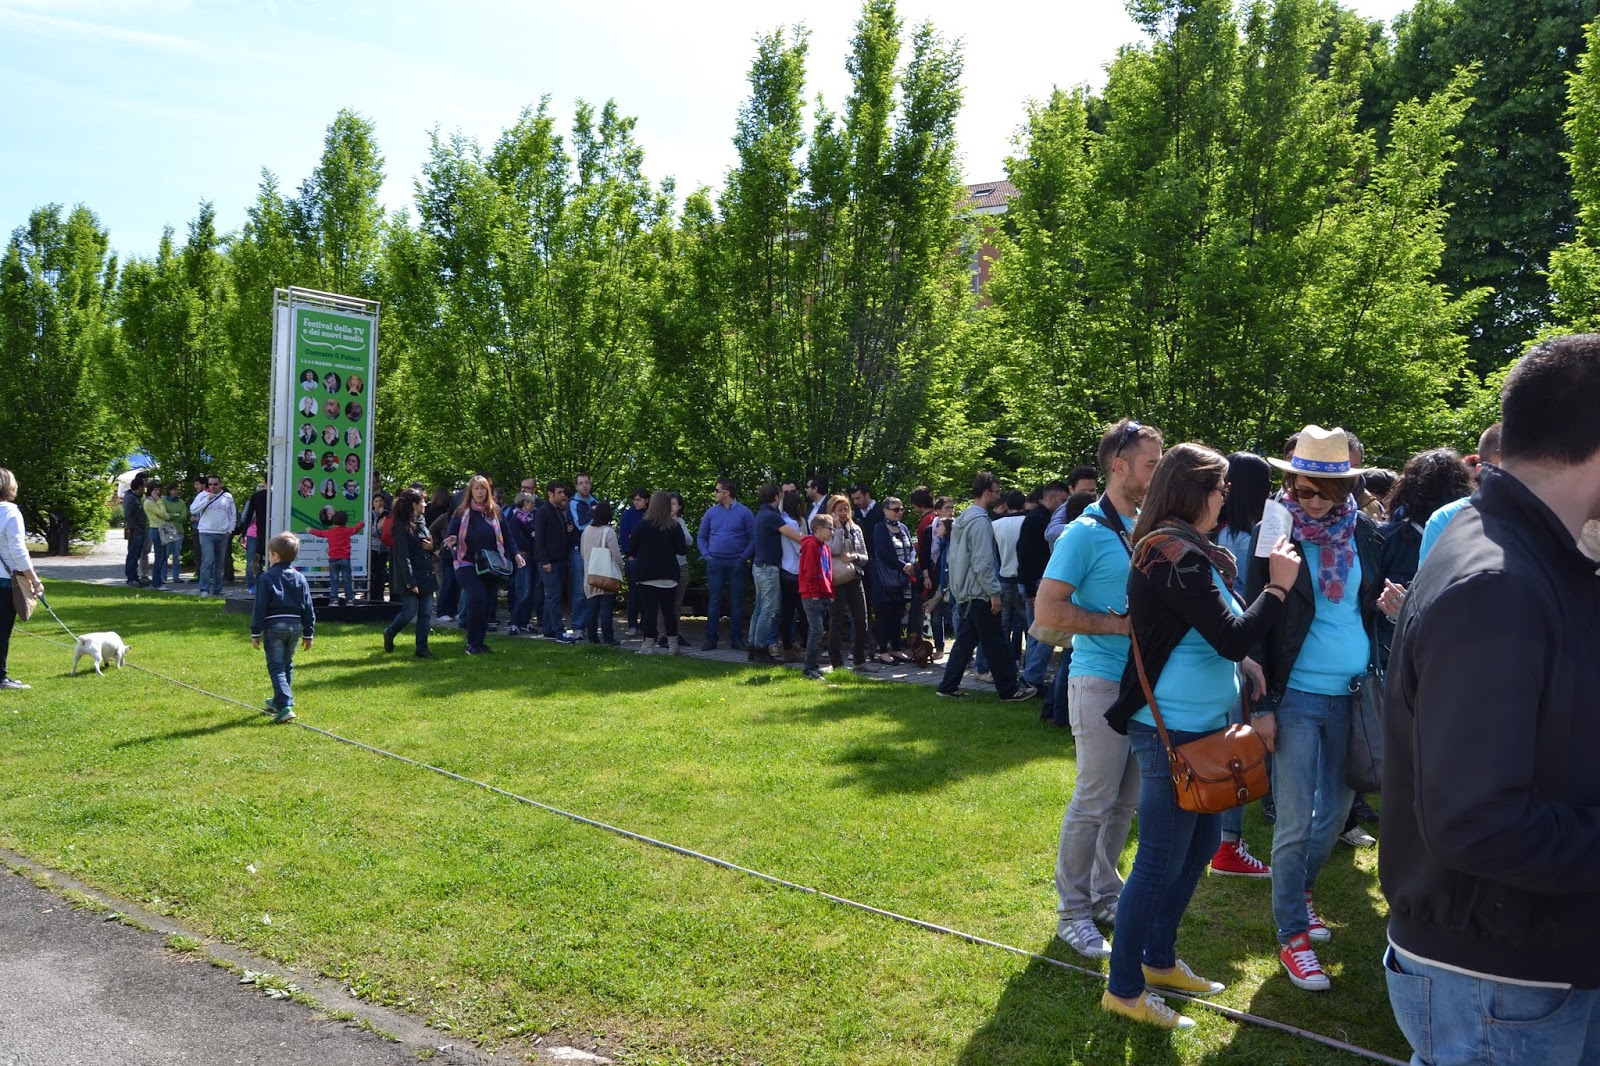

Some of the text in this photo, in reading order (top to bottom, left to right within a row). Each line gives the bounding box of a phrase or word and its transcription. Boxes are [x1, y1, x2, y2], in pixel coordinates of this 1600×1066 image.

[303, 317, 332, 330] Festival
[334, 324, 352, 333] della
[305, 349, 333, 358] Costruire
